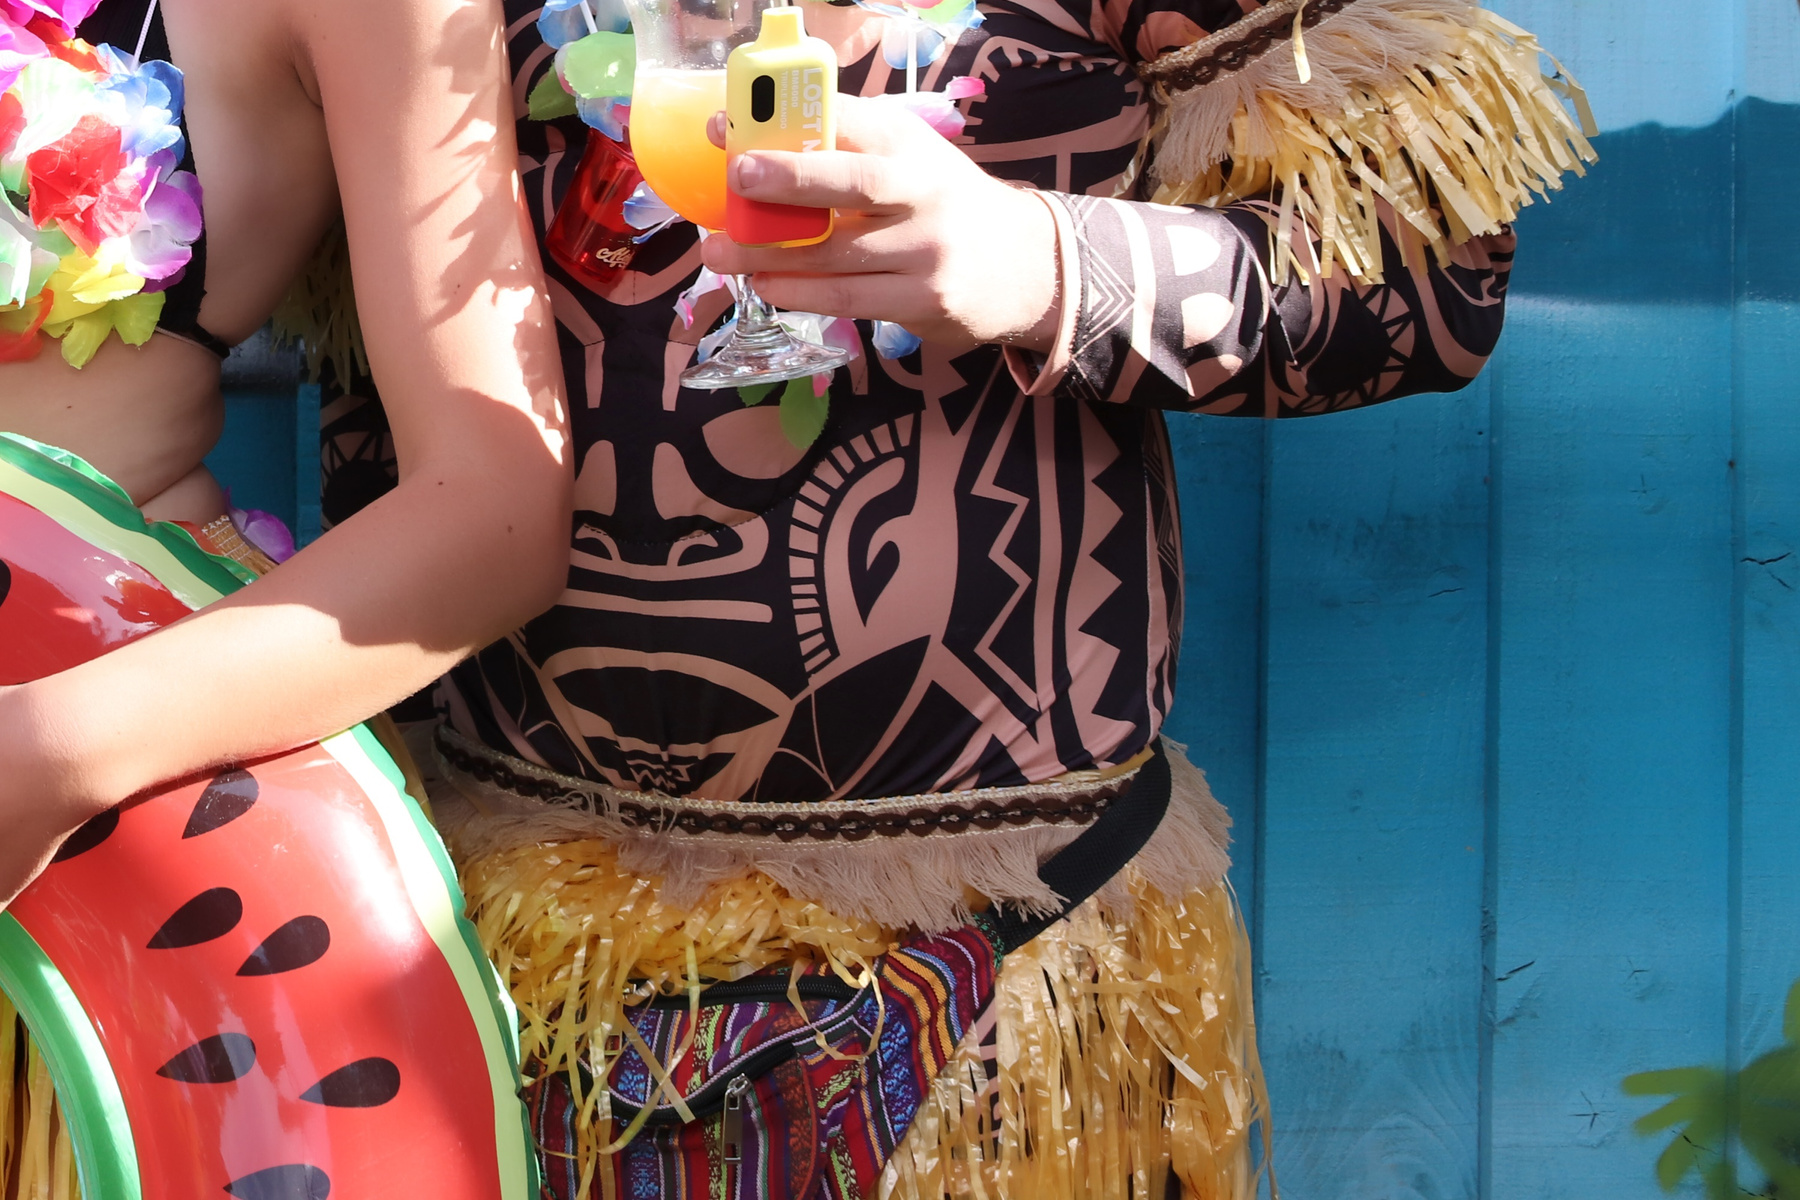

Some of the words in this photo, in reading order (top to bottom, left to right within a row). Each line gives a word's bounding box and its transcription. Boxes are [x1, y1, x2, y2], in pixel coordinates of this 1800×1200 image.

[780, 71, 788, 98] TRIPLE
[791, 69, 800, 108] BM6000
[802, 67, 823, 133] LOST
[780, 100, 788, 129] MANGO
